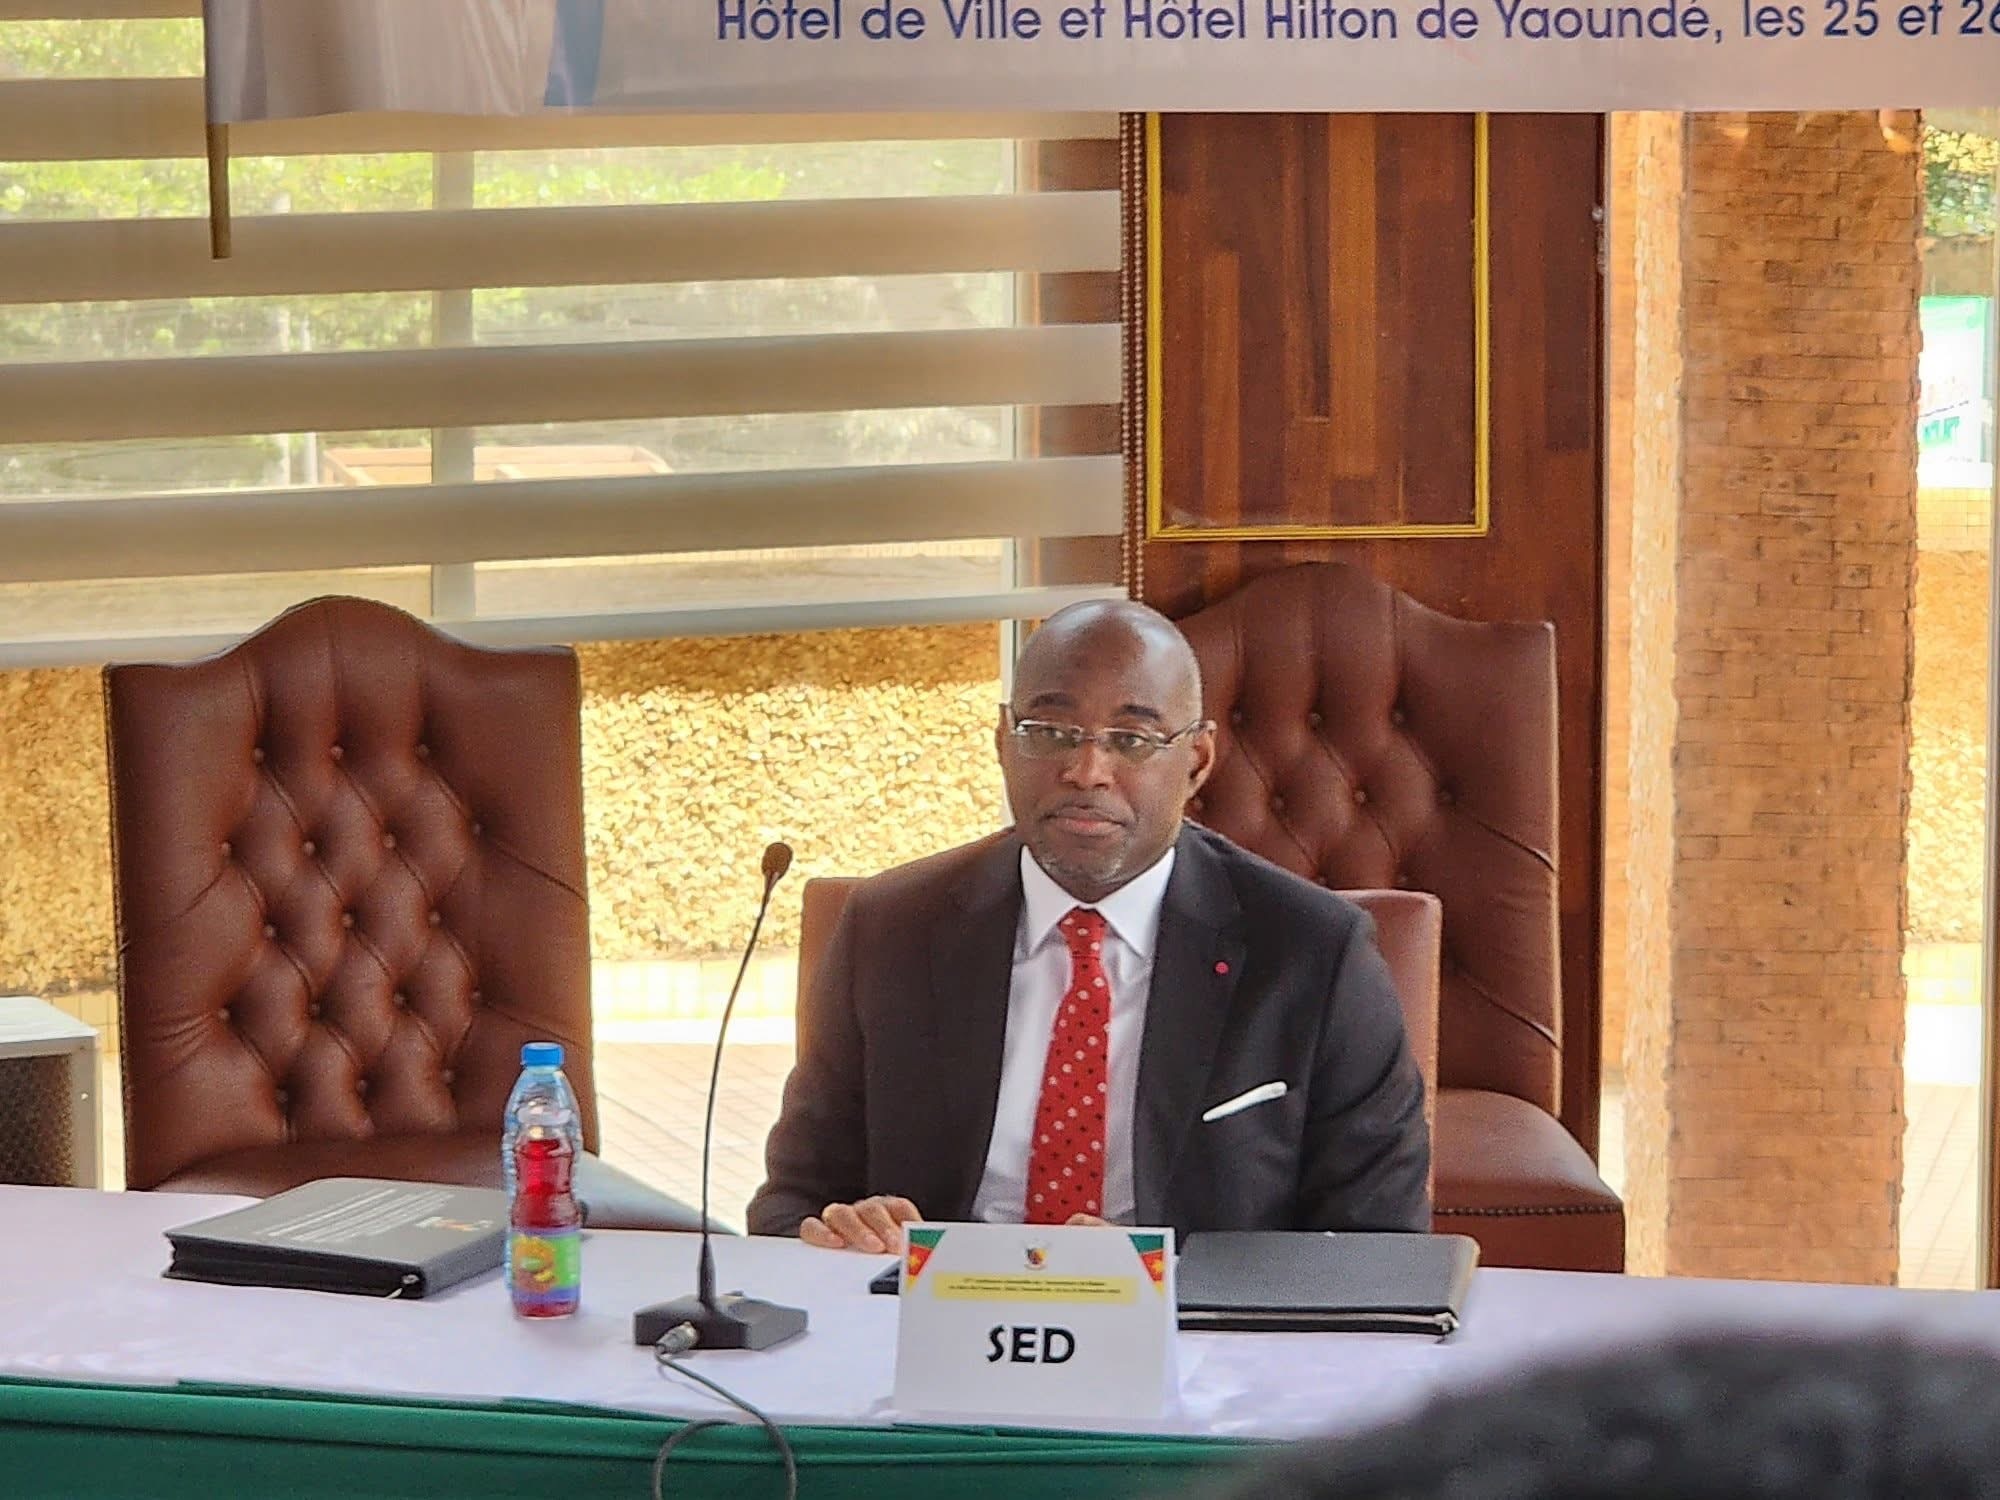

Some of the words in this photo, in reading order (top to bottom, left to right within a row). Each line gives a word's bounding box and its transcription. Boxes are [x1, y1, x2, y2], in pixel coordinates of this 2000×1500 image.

[717, 0, 842, 41] Hôtel
[860, 0, 926, 40] de
[941, 0, 1042, 40] Ville
[1059, 0, 1106, 40] et
[1124, 0, 1246, 40] Hôtel
[1265, 0, 1398, 40] Hilton
[1416, 0, 1479, 40] de
[1494, 0, 1722, 45] Yaoundé,
[1743, 0, 1806, 38] les
[1823, 0, 1880, 37] 25
[1897, 0, 1944, 37] et
[986, 1325, 1076, 1364] SED
